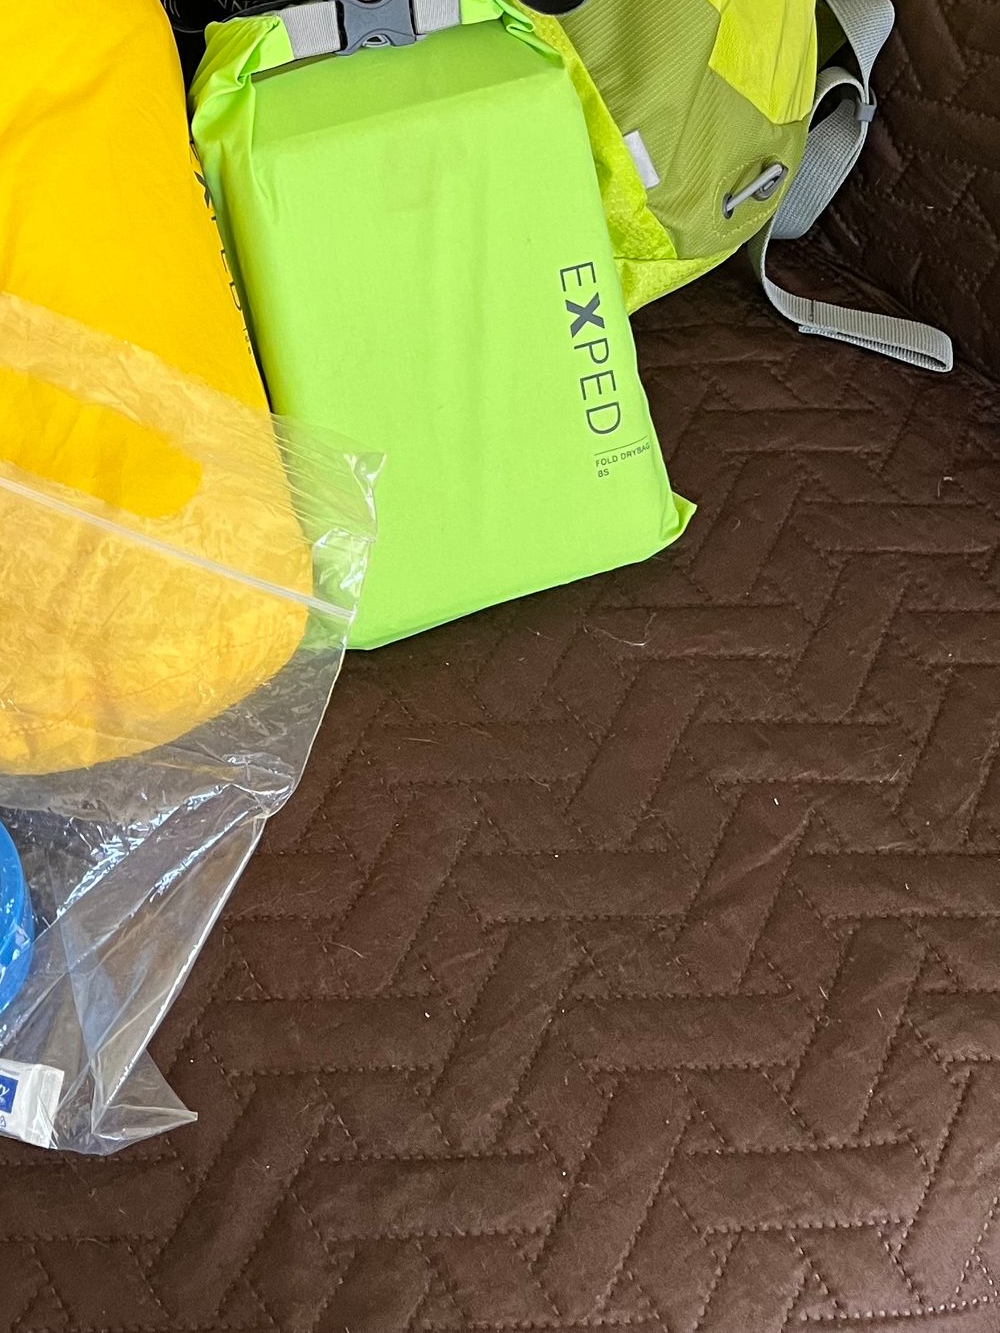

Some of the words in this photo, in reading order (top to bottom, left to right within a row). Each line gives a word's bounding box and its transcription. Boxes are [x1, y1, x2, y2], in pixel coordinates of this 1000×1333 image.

[559, 261, 622, 435] EXPED
[595, 455, 619, 467] FOLD
[620, 442, 651, 460] DRYBAG
